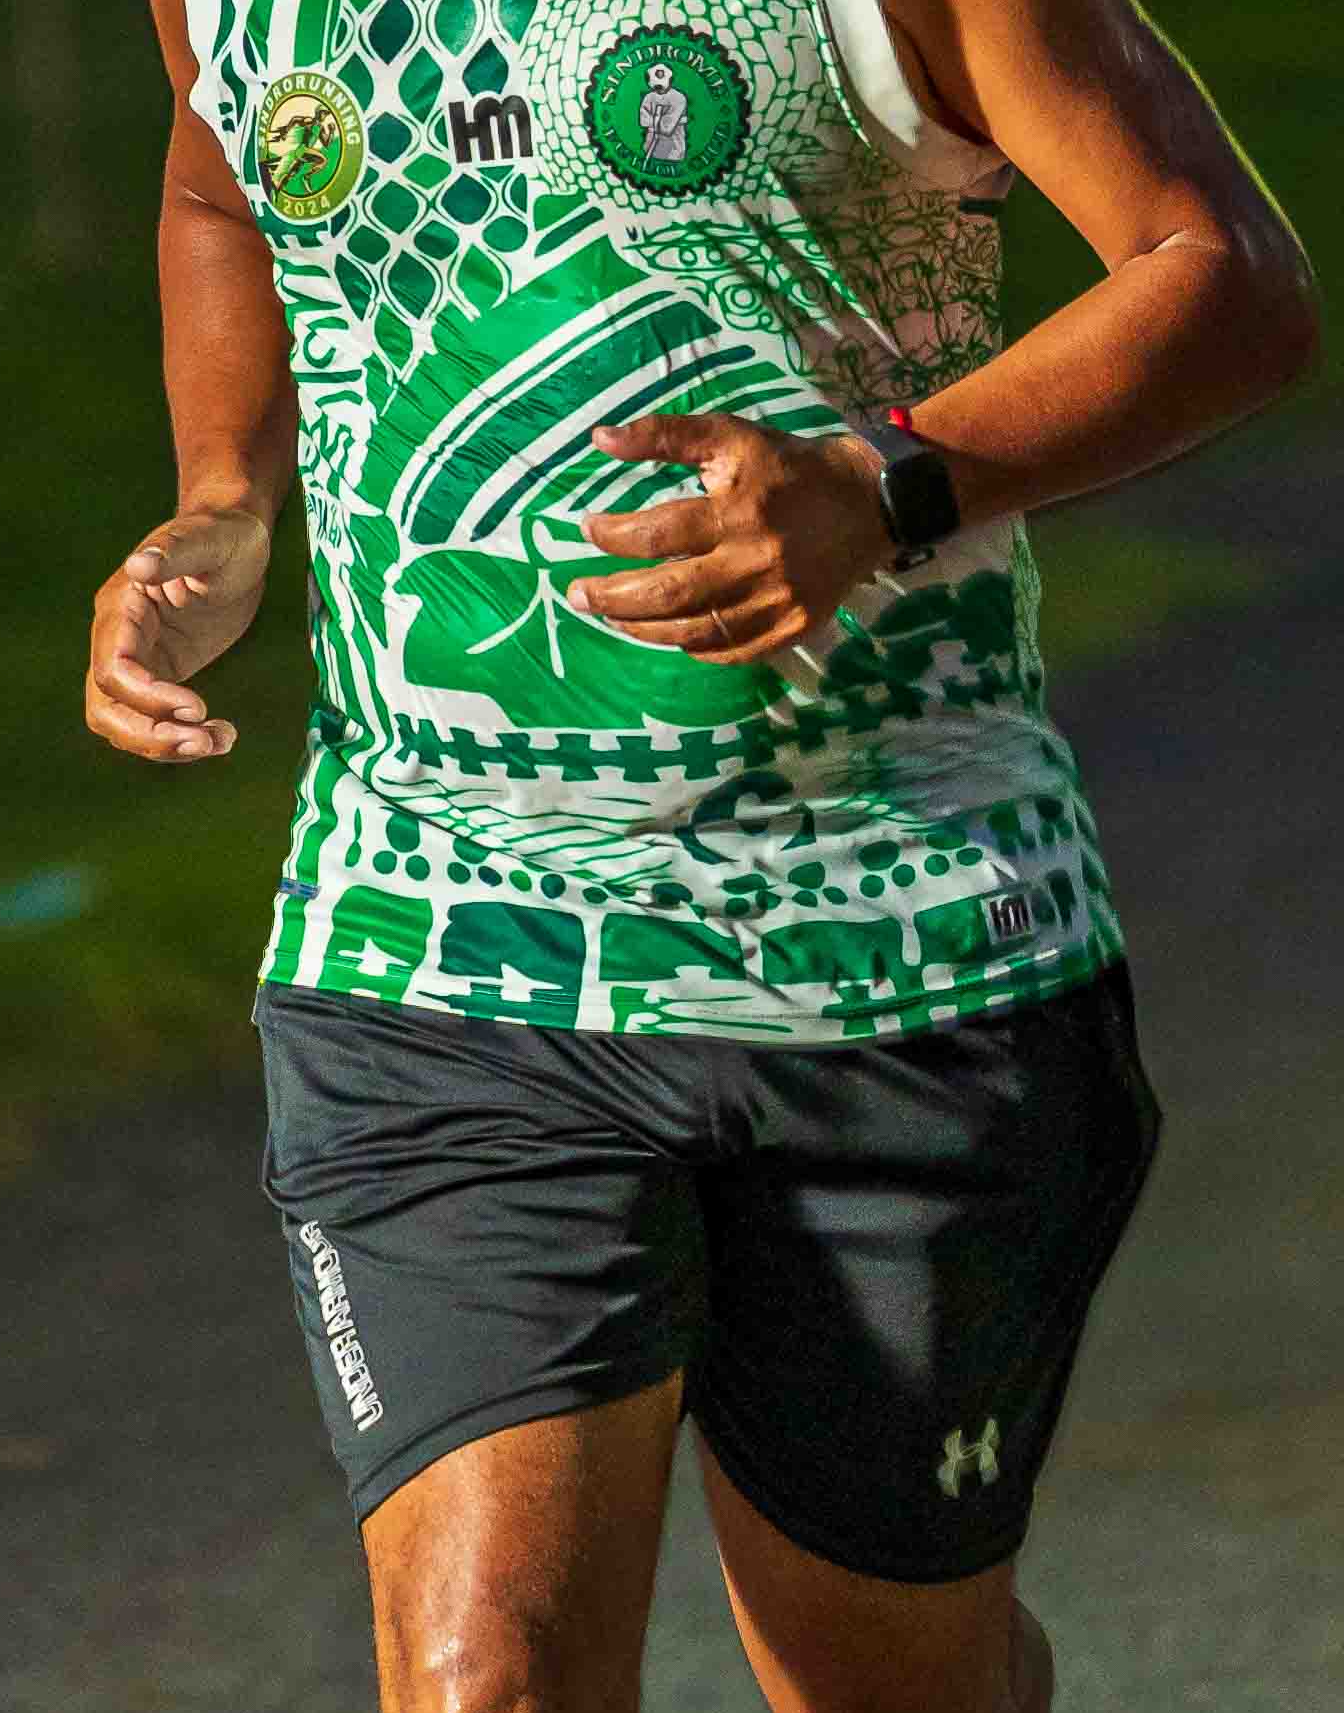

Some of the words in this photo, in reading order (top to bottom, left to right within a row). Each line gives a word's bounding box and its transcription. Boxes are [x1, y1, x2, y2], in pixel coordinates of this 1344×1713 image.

[283, 197, 330, 217] 2024
[299, 1219, 354, 1335] ARMOUR
[330, 1327, 383, 1431] UNDER
